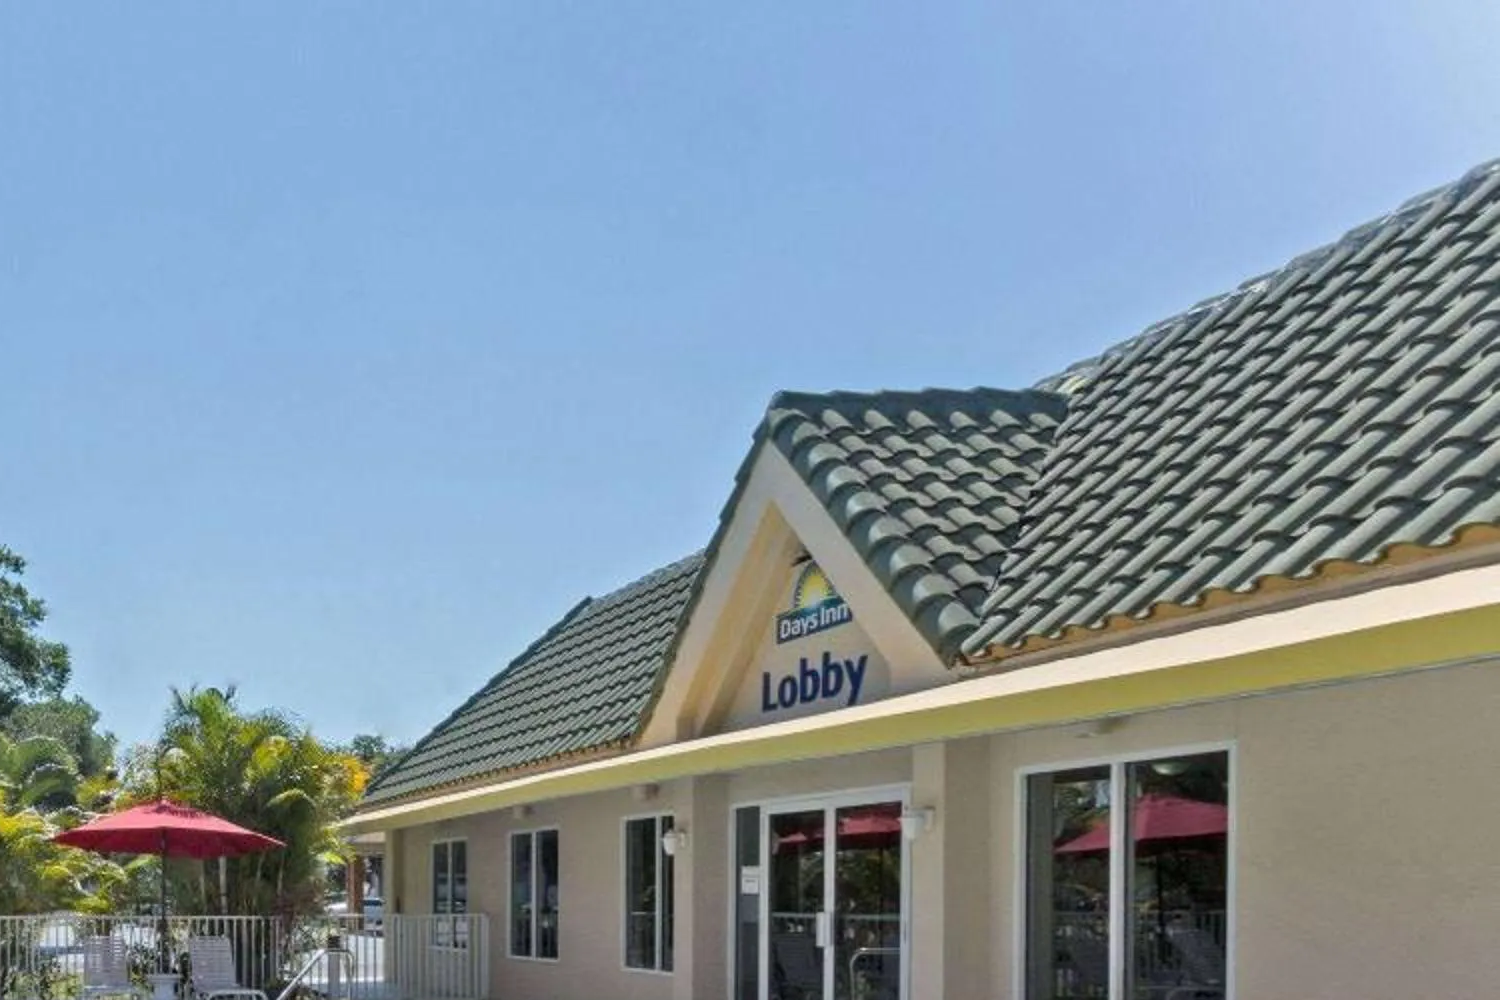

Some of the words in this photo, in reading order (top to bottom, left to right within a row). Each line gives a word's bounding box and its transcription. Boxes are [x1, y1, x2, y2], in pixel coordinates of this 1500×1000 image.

[780, 613, 818, 639] Days
[821, 604, 849, 626] Inn
[762, 651, 868, 712] Lobby
